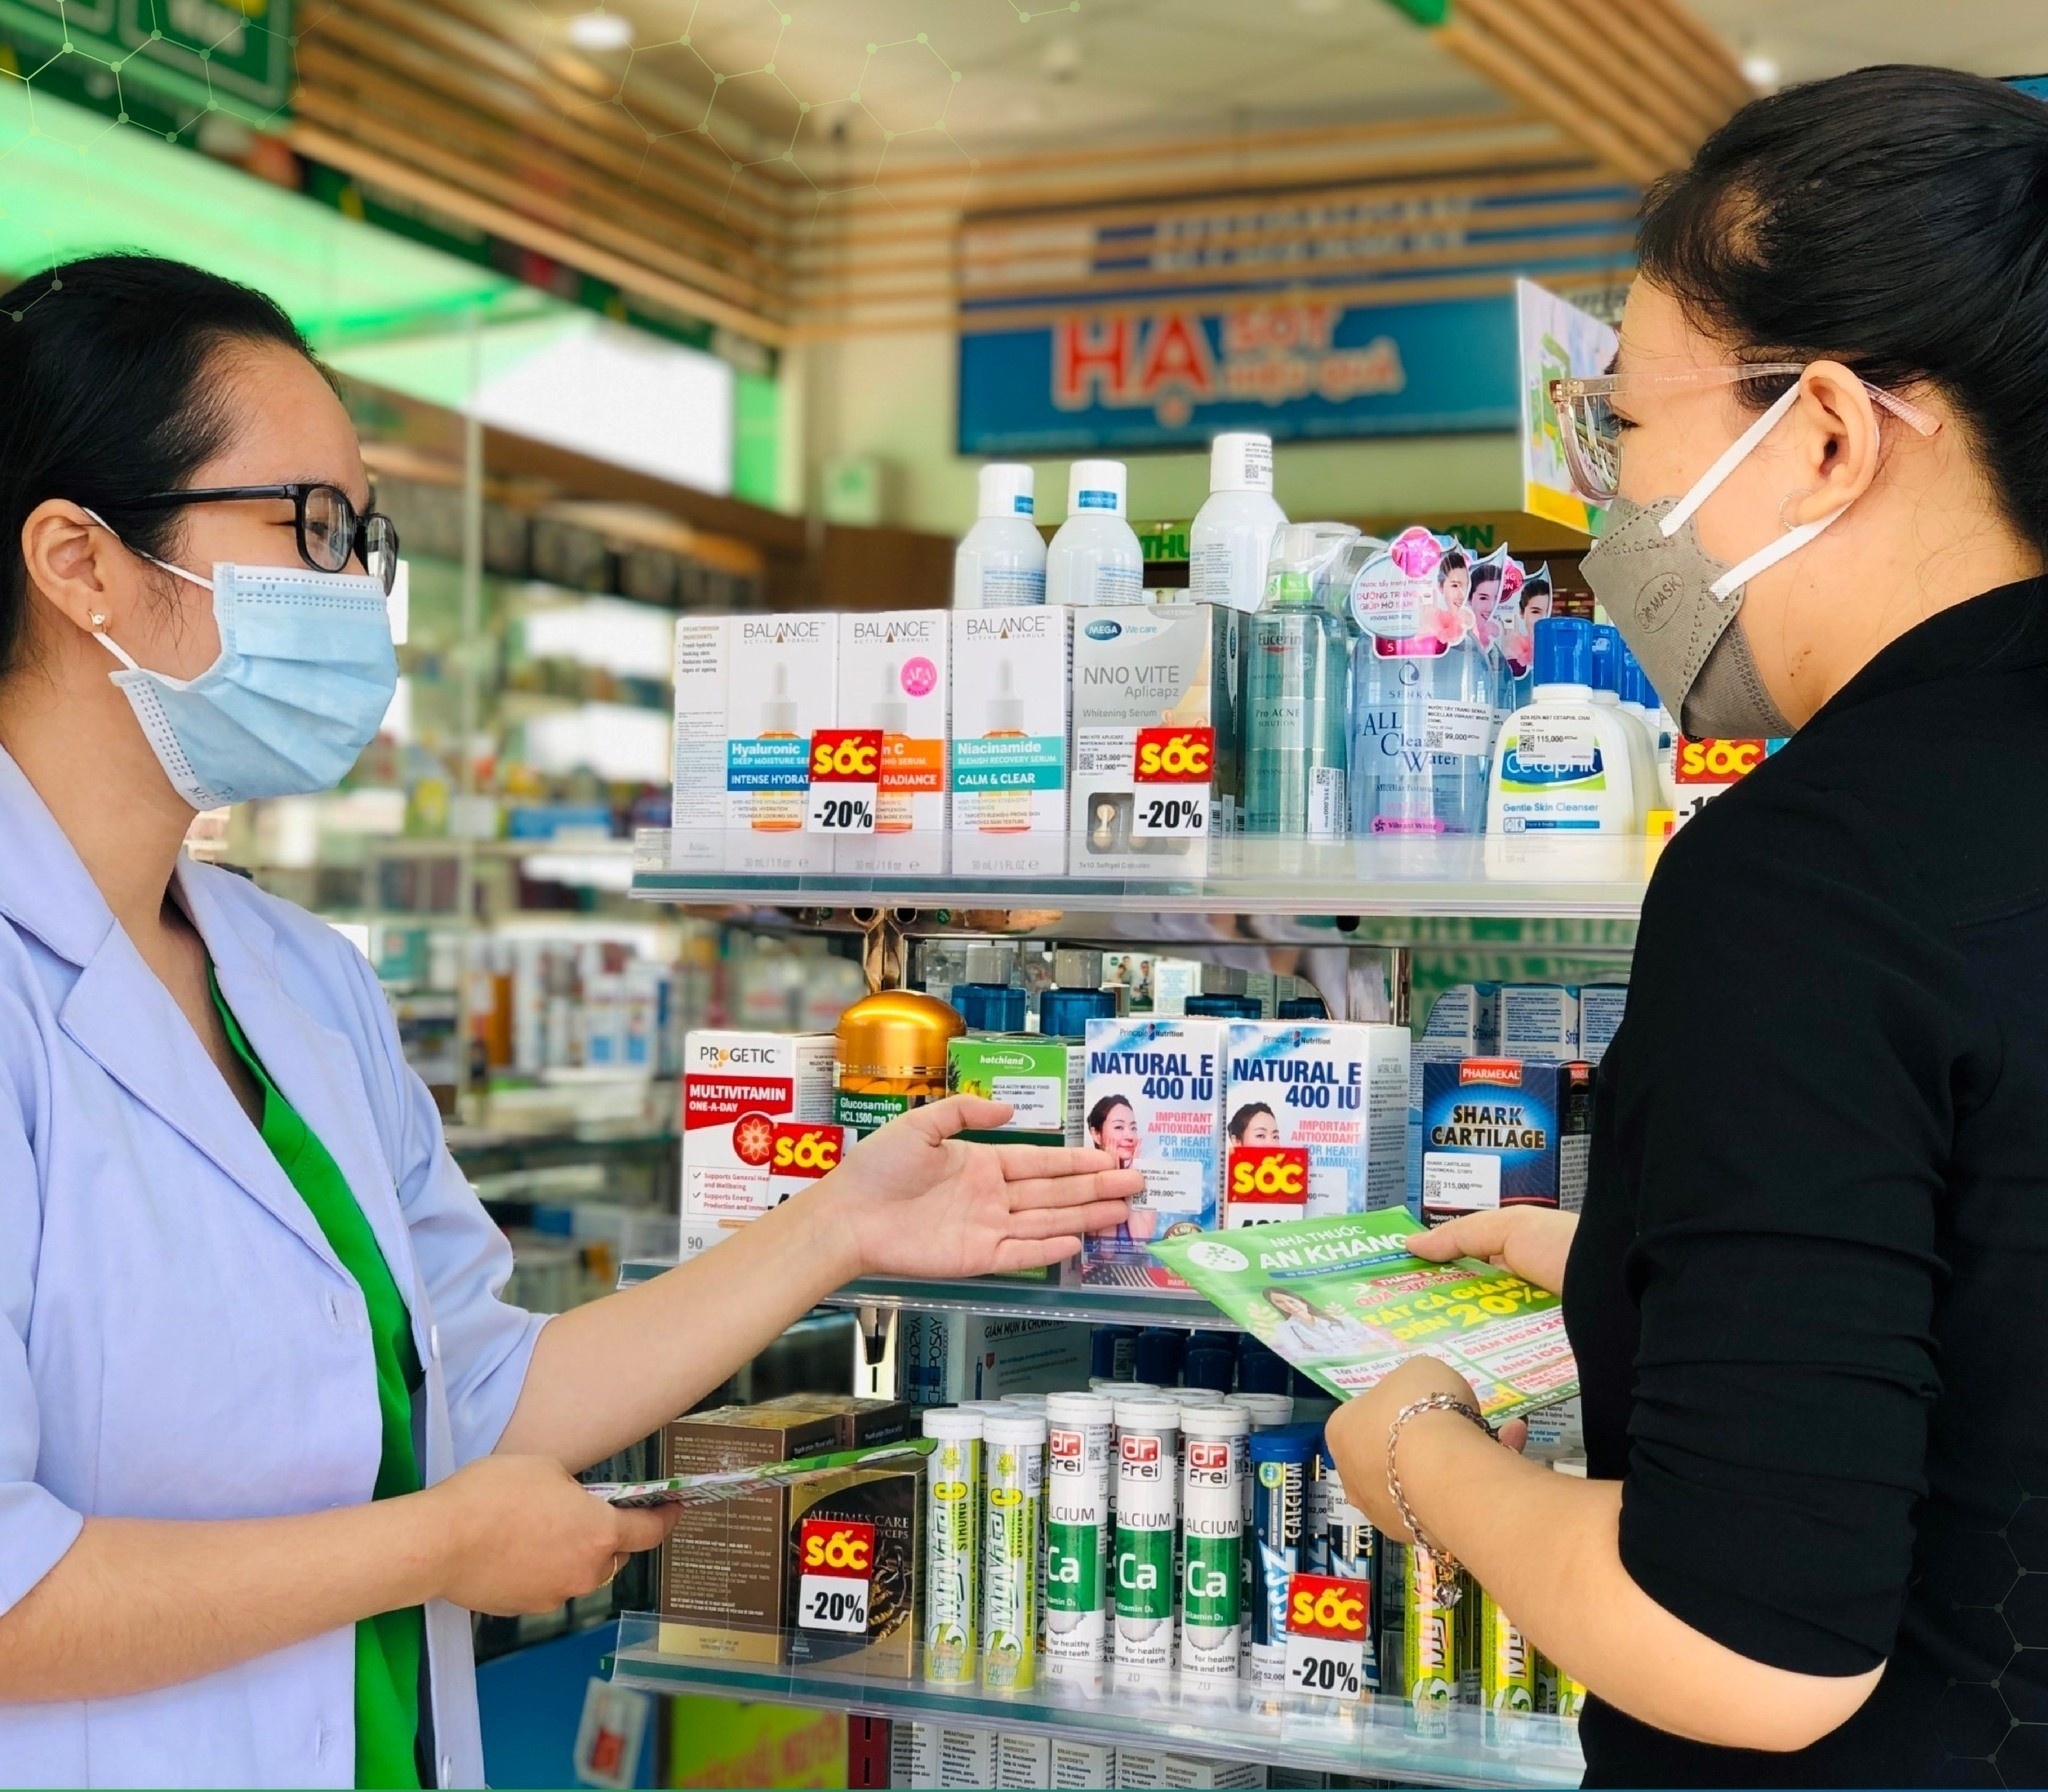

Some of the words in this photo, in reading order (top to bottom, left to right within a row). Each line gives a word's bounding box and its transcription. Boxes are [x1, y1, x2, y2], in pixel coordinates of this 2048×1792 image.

[1650, 576, 1681, 612] MASK
[1156, 609, 1197, 617] WHITENING
[743, 621, 820, 638] BALANCE
[854, 620, 930, 638] BALANCE
[966, 615, 1046, 635] BALANCE
[1088, 625, 1118, 634] MEGA
[1125, 625, 1139, 633] We
[1257, 631, 1302, 646] Eucerin
[1083, 666, 1130, 685] NNO
[1135, 665, 1180, 684] VITE
[1124, 686, 1179, 700] Aplicapz
[1388, 690, 1433, 699] SENKA
[1083, 709, 1127, 719] Whitening
[1129, 709, 1157, 718] Serum
[1255, 708, 1269, 718] Pro
[1271, 708, 1300, 718] ACNE
[1361, 711, 1403, 737] ALL
[1444, 732, 1467, 740] 99,000
[1537, 735, 1564, 744] 115,000
[731, 743, 801, 758] Hyaluronic
[812, 737, 878, 775] SỐC
[957, 742, 1042, 755] Niacinamide
[1138, 733, 1210, 774] SỐC
[732, 757, 752, 765] DEEP
[754, 757, 795, 765] MOISTURE
[895, 757, 926, 765] SERUM
[958, 757, 989, 765] BLEMISH
[990, 756, 1029, 764] RECOVERY
[1031, 755, 1057, 763] SERUM
[1401, 751, 1459, 773] Water
[731, 774, 769, 785] INTENSE
[883, 774, 938, 786] RADIANCE
[957, 774, 988, 785] CALM
[990, 773, 998, 785] &
[1000, 772, 1036, 784] CLEAR
[1375, 783, 1405, 792] Micellar
[1407, 784, 1441, 793] Formula
[813, 800, 873, 829] -20%
[1138, 800, 1203, 829] -20%
[1503, 803, 1532, 812] Gentle
[1534, 803, 1553, 812] Skin
[1555, 803, 1600, 812] Cleanser
[1387, 821, 1415, 830] Vibrant
[1415, 822, 1438, 830] White
[1096, 861, 1121, 870] Softgel
[1119, 1028, 1148, 1038] Principle
[1155, 1030, 1184, 1038] Nutrition
[1262, 1035, 1293, 1044] Principle
[1300, 1037, 1331, 1045] Nutrition
[700, 1046, 775, 1064] PROGETIC
[1091, 1051, 1192, 1077] NATURAL
[1200, 1054, 1214, 1077] E
[1232, 1058, 1340, 1085] NATURAL
[1348, 1061, 1362, 1086] E
[1462, 1067, 1520, 1081] PHARMEKAL
[689, 1083, 787, 1102] MULTIVITAMIN
[1141, 1077, 1184, 1101] 400
[1191, 1077, 1213, 1101] IU
[840, 1096, 903, 1112] Glucosamine
[1285, 1084, 1330, 1109] 400
[1337, 1086, 1361, 1110] IU
[688, 1101, 739, 1113] ONE-A-DAY
[840, 1110, 855, 1122] HCL
[855, 1111, 873, 1124] 1500
[873, 1115, 887, 1125] mg
[1155, 1111, 1214, 1123] IMPORTANT
[1452, 1104, 1525, 1126] SHARK
[1147, 1122, 1214, 1135] ANTIOXIDANT
[1298, 1120, 1361, 1133] IMPORTANT
[1159, 1135, 1178, 1147] FOR
[1180, 1135, 1212, 1147] HEART
[1290, 1131, 1361, 1145] ANTIOXIDANT
[1430, 1125, 1547, 1150] CARTILAGE
[773, 1130, 838, 1170] SỐC
[1161, 1147, 1170, 1158] &
[1172, 1148, 1213, 1159] IMMUNE
[1325, 1144, 1360, 1157] HEART
[1316, 1156, 1360, 1168] IMMUNE
[704, 1172, 731, 1181] Supports
[732, 1173, 757, 1182] General
[1231, 1153, 1304, 1195] SỐC
[716, 1182, 747, 1192] Wellbeing
[1442, 1181, 1471, 1190] 315,000
[703, 1192, 731, 1202] Supports
[732, 1194, 754, 1203] Energy
[1148, 1189, 1175, 1198] 299,000
[703, 1202, 735, 1211] Production
[687, 1236, 703, 1250] 90
[1269, 1232, 1310, 1249] NHÀ
[1309, 1224, 1368, 1243] THUỐC
[1259, 1248, 1304, 1271] AN
[1304, 1232, 1408, 1265] KHANG
[1360, 1302, 1415, 1327] TẤT
[1414, 1291, 1456, 1311] CẢ
[1450, 1276, 1529, 1301] GIẢM
[1391, 1314, 1453, 1341] ĐẾN
[1446, 1289, 1552, 1328] 20%
[928, 1316, 943, 1368] POSAY
[1503, 1326, 1543, 1344] NGAY
[1532, 1345, 1565, 1361] 100
[1051, 1433, 1079, 1454] dr.
[1122, 1438, 1158, 1461] dr.
[1191, 1445, 1226, 1468] dr.
[1121, 1462, 1159, 1478] Frei
[1189, 1467, 1228, 1485] Frei
[1285, 1462, 1303, 1539] CALCIUM
[874, 1515, 909, 1529] CARE
[958, 1502, 968, 1551] STRONG
[1186, 1519, 1240, 1535] ALCIUM
[804, 1530, 869, 1571] SỐC
[932, 1505, 965, 1620] MyVita
[988, 1511, 1019, 1626] MyVita
[1048, 1546, 1080, 1584] Ca
[1118, 1552, 1158, 1591] Ca
[1187, 1560, 1228, 1599] Ca
[805, 1592, 864, 1623] -20%
[1291, 1587, 1365, 1632] SỐC
[1051, 1638, 1059, 1647] for
[1060, 1639, 1090, 1650] healthy
[1125, 1645, 1136, 1655] for
[1137, 1646, 1166, 1656] healthy
[1068, 1649, 1090, 1658] teeth
[1130, 1656, 1145, 1664] and
[1146, 1656, 1166, 1665] teeth
[1194, 1654, 1206, 1663] for
[1206, 1654, 1236, 1665] healthy
[1051, 1664, 1063, 1675] 20
[1199, 1664, 1215, 1673] and
[1216, 1665, 1236, 1674] teeth
[1292, 1657, 1358, 1694] -20%
[1127, 1672, 1140, 1683] 20
